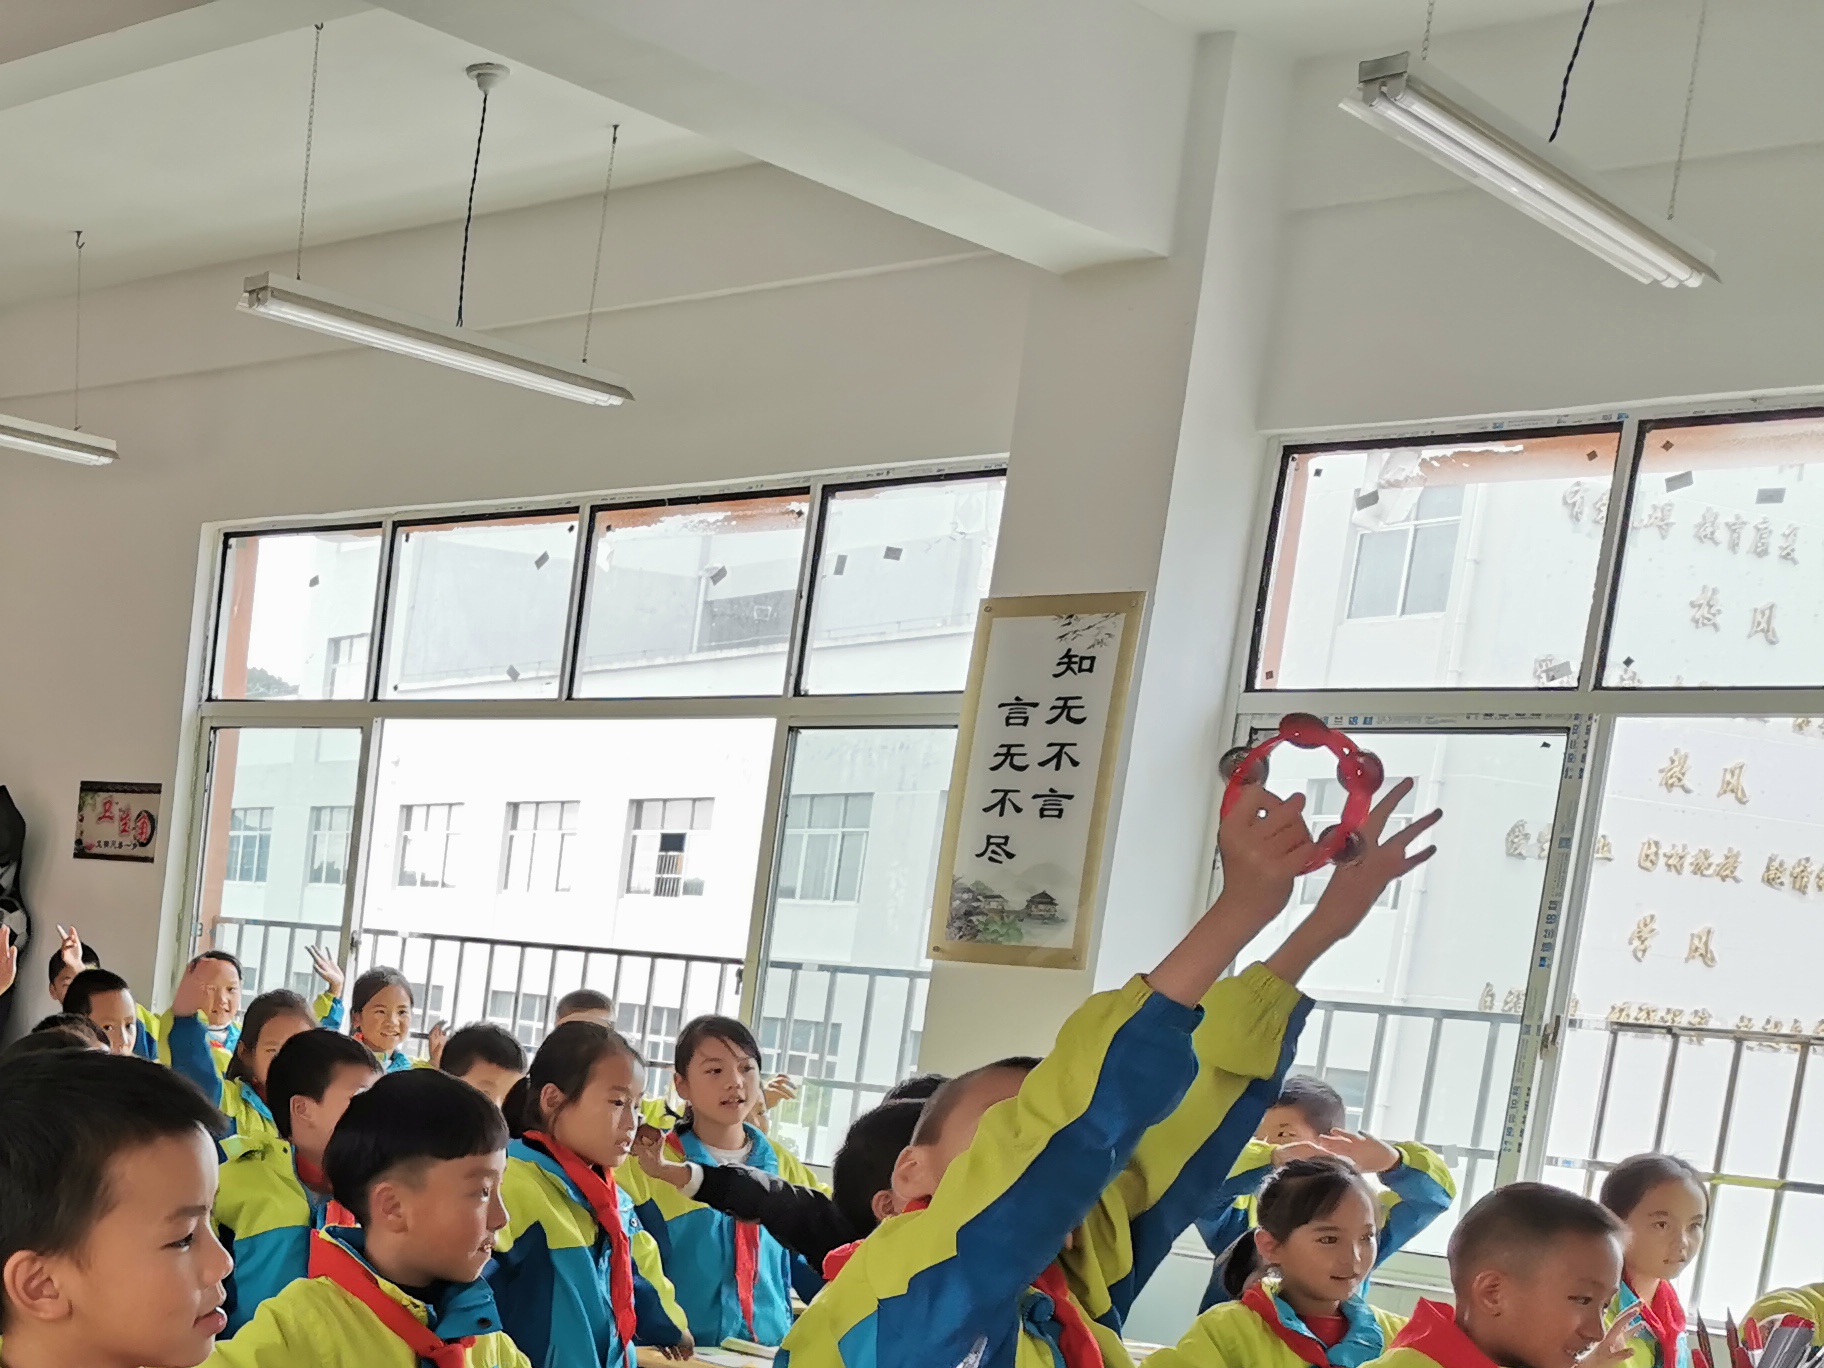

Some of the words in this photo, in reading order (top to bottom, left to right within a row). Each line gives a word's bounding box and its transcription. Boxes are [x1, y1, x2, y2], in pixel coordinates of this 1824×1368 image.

[1031, 647, 1097, 820] 知无不言
[974, 695, 1040, 865] 言无不尽
[1659, 747, 1750, 805] 教风
[96, 797, 152, 844] 卫生角
[1629, 912, 1718, 968] 学风
